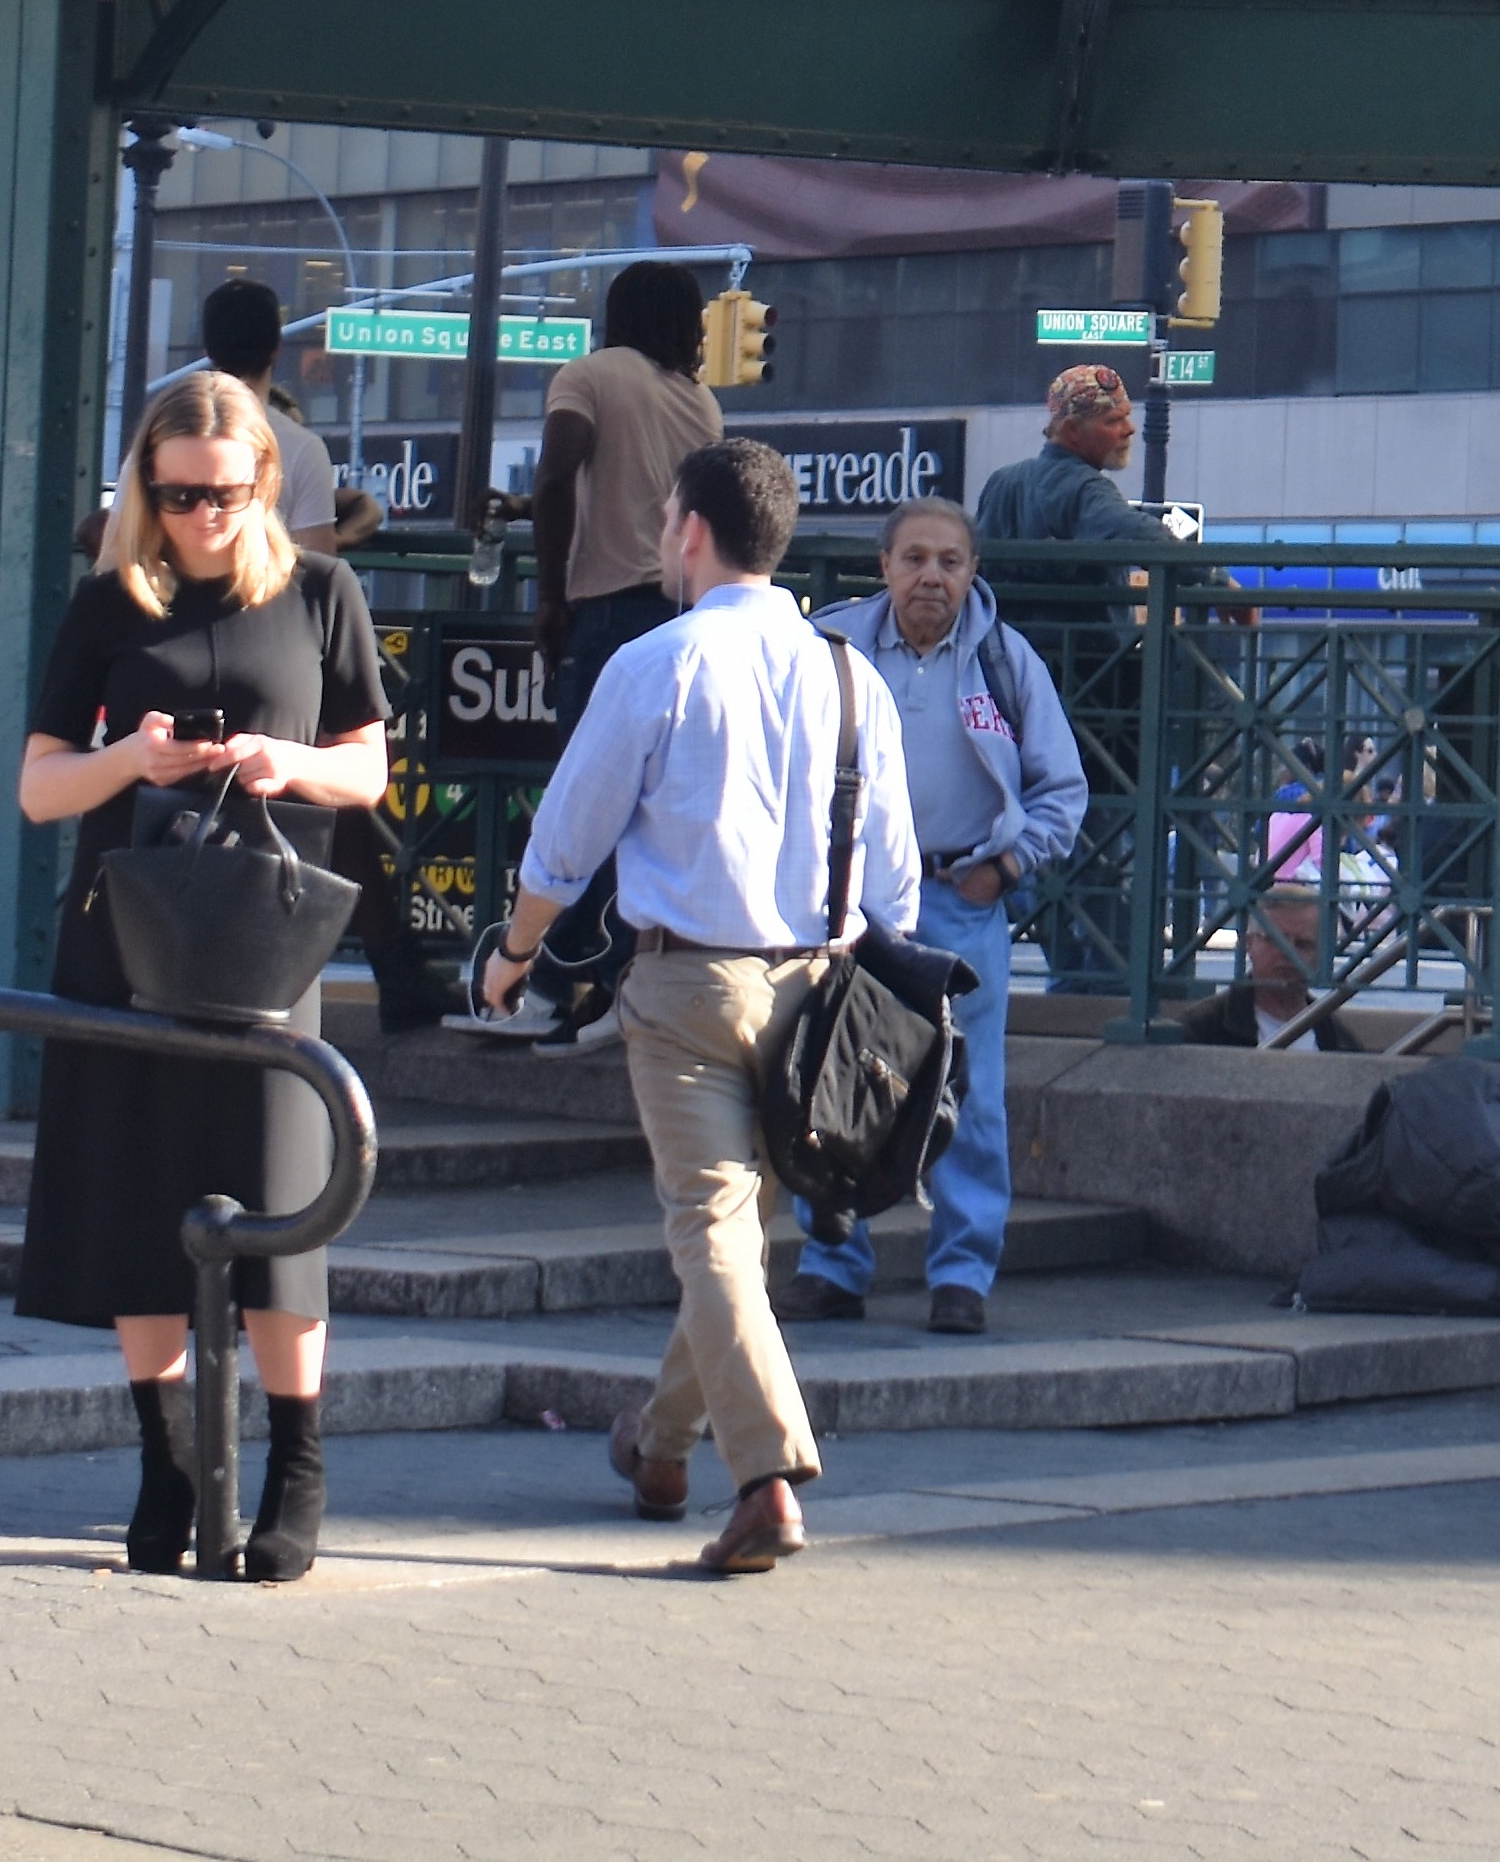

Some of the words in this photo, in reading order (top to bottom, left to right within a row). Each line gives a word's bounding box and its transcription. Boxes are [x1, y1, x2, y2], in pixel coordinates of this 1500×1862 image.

[1043, 314, 1085, 331] UNION
[1091, 315, 1145, 332] SQUARE
[338, 322, 415, 346] Union
[421, 326, 513, 350] Sque
[519, 330, 577, 351] East
[1167, 356, 1175, 379] E
[1181, 356, 1195, 379] 14
